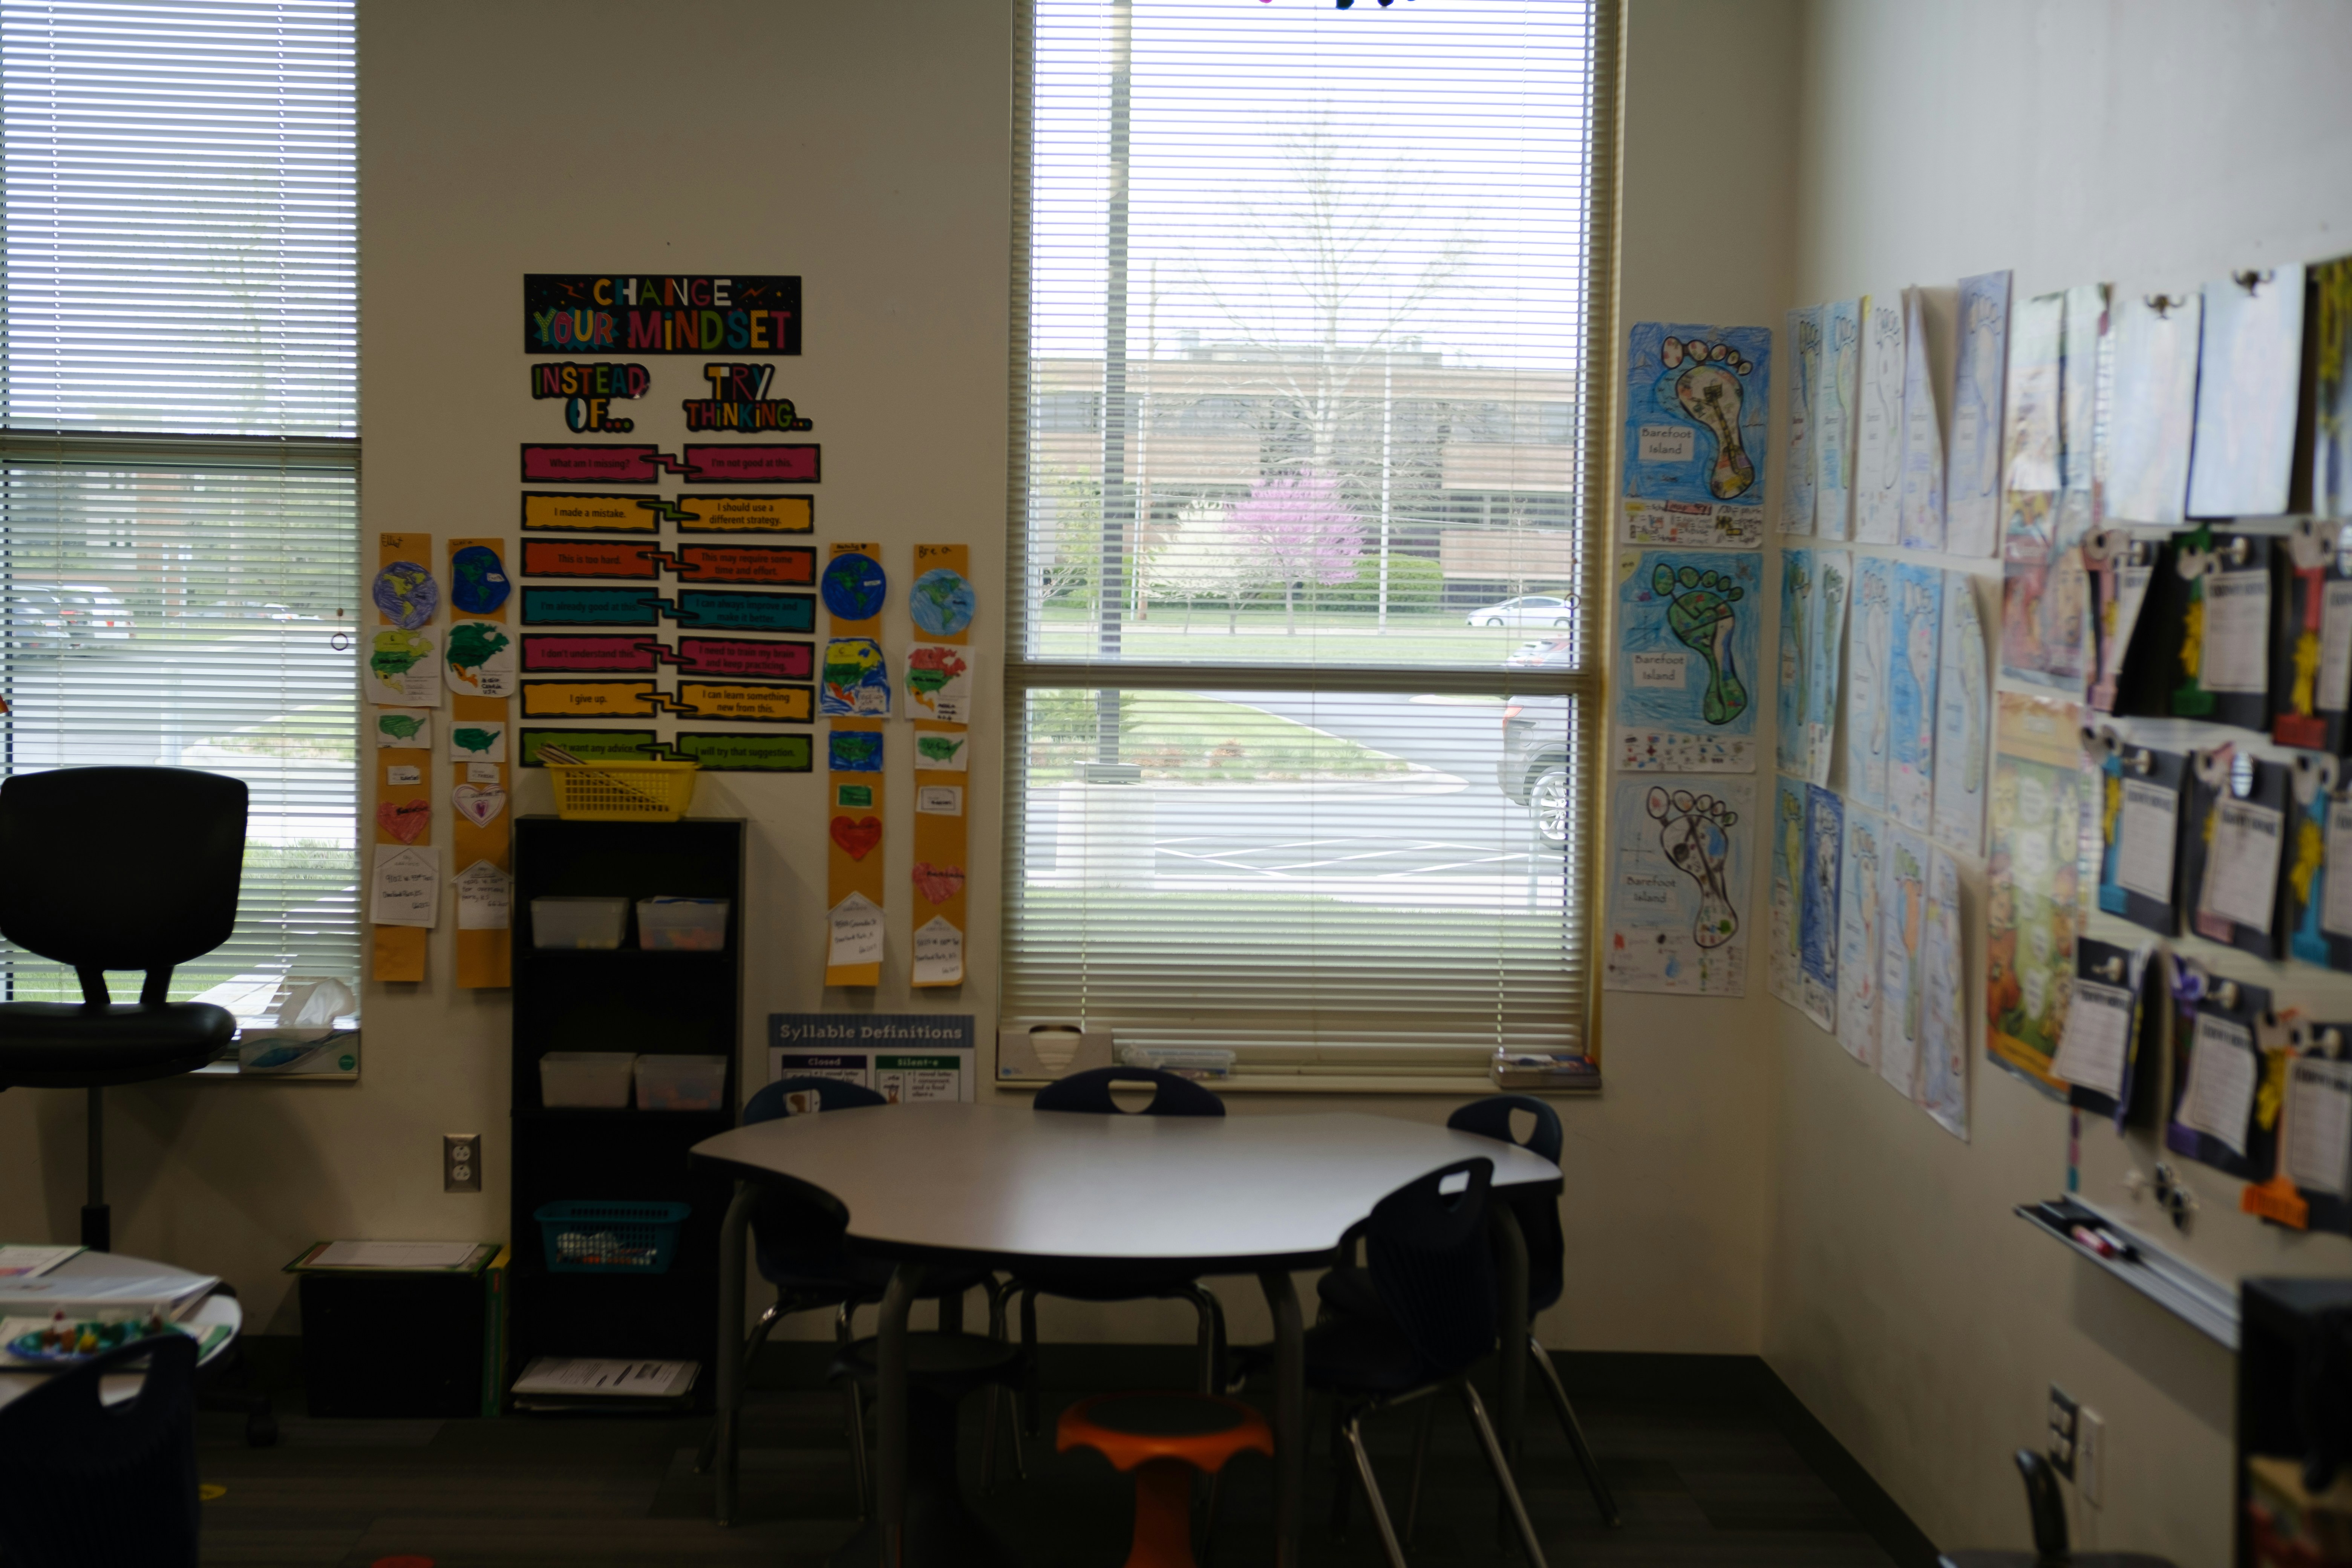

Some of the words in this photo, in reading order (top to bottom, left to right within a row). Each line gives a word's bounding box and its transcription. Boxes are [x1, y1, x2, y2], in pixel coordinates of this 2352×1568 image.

[593, 278, 732, 306] CHANGE
[533, 308, 613, 345] YOUR
[535, 366, 648, 396] INSTEAD
[708, 366, 772, 401] TRY
[568, 398, 630, 429] OF...
[1642, 427, 1692, 438] Barefoot
[1649, 443, 1682, 454] Island
[550, 459, 571, 467] What
[594, 459, 630, 470] missing?
[712, 458, 724, 467] I'm
[743, 459, 763, 470] good
[775, 458, 792, 467] this.
[723, 503, 749, 511] should
[592, 509, 626, 518] mistake.
[709, 515, 744, 524] different
[747, 516, 782, 526] strategy.
[558, 554, 574, 562] This
[601, 556, 621, 564] hard.
[702, 553, 716, 561] This
[720, 554, 736, 564] may
[739, 555, 767, 564] require
[735, 566, 750, 574] and
[753, 566, 777, 576] effort.
[541, 602, 554, 610] I'm
[556, 602, 585, 612] already
[588, 603, 608, 613] good
[622, 602, 638, 611] this.
[717, 600, 744, 609] always
[747, 600, 779, 611] improve
[782, 602, 797, 611] and
[750, 614, 776, 623] better.
[619, 649, 635, 658] this.
[738, 647, 756, 655] train
[759, 649, 771, 658] my
[774, 649, 794, 658] brain
[1635, 653, 1684, 665] Barefoot
[723, 660, 742, 669] keep
[745, 660, 787, 672] practicing.
[1643, 669, 1675, 680] Island
[575, 695, 592, 705] give
[594, 696, 607, 705] up.
[724, 691, 744, 699] learn
[747, 692, 790, 704] something
[736, 703, 755, 712] from
[758, 704, 774, 713] this.
[591, 745, 605, 755] any
[608, 744, 635, 753] advice.
[717, 748, 728, 758] try
[749, 748, 796, 759] suggestion.
[1627, 875, 1676, 887] Barefoot
[1634, 891, 1667, 903] Island
[779, 1024, 856, 1041] Syllable
[861, 1025, 962, 1039] Definitions
[807, 1058, 841, 1066] Closed
[897, 1058, 939, 1066] Silent-e
